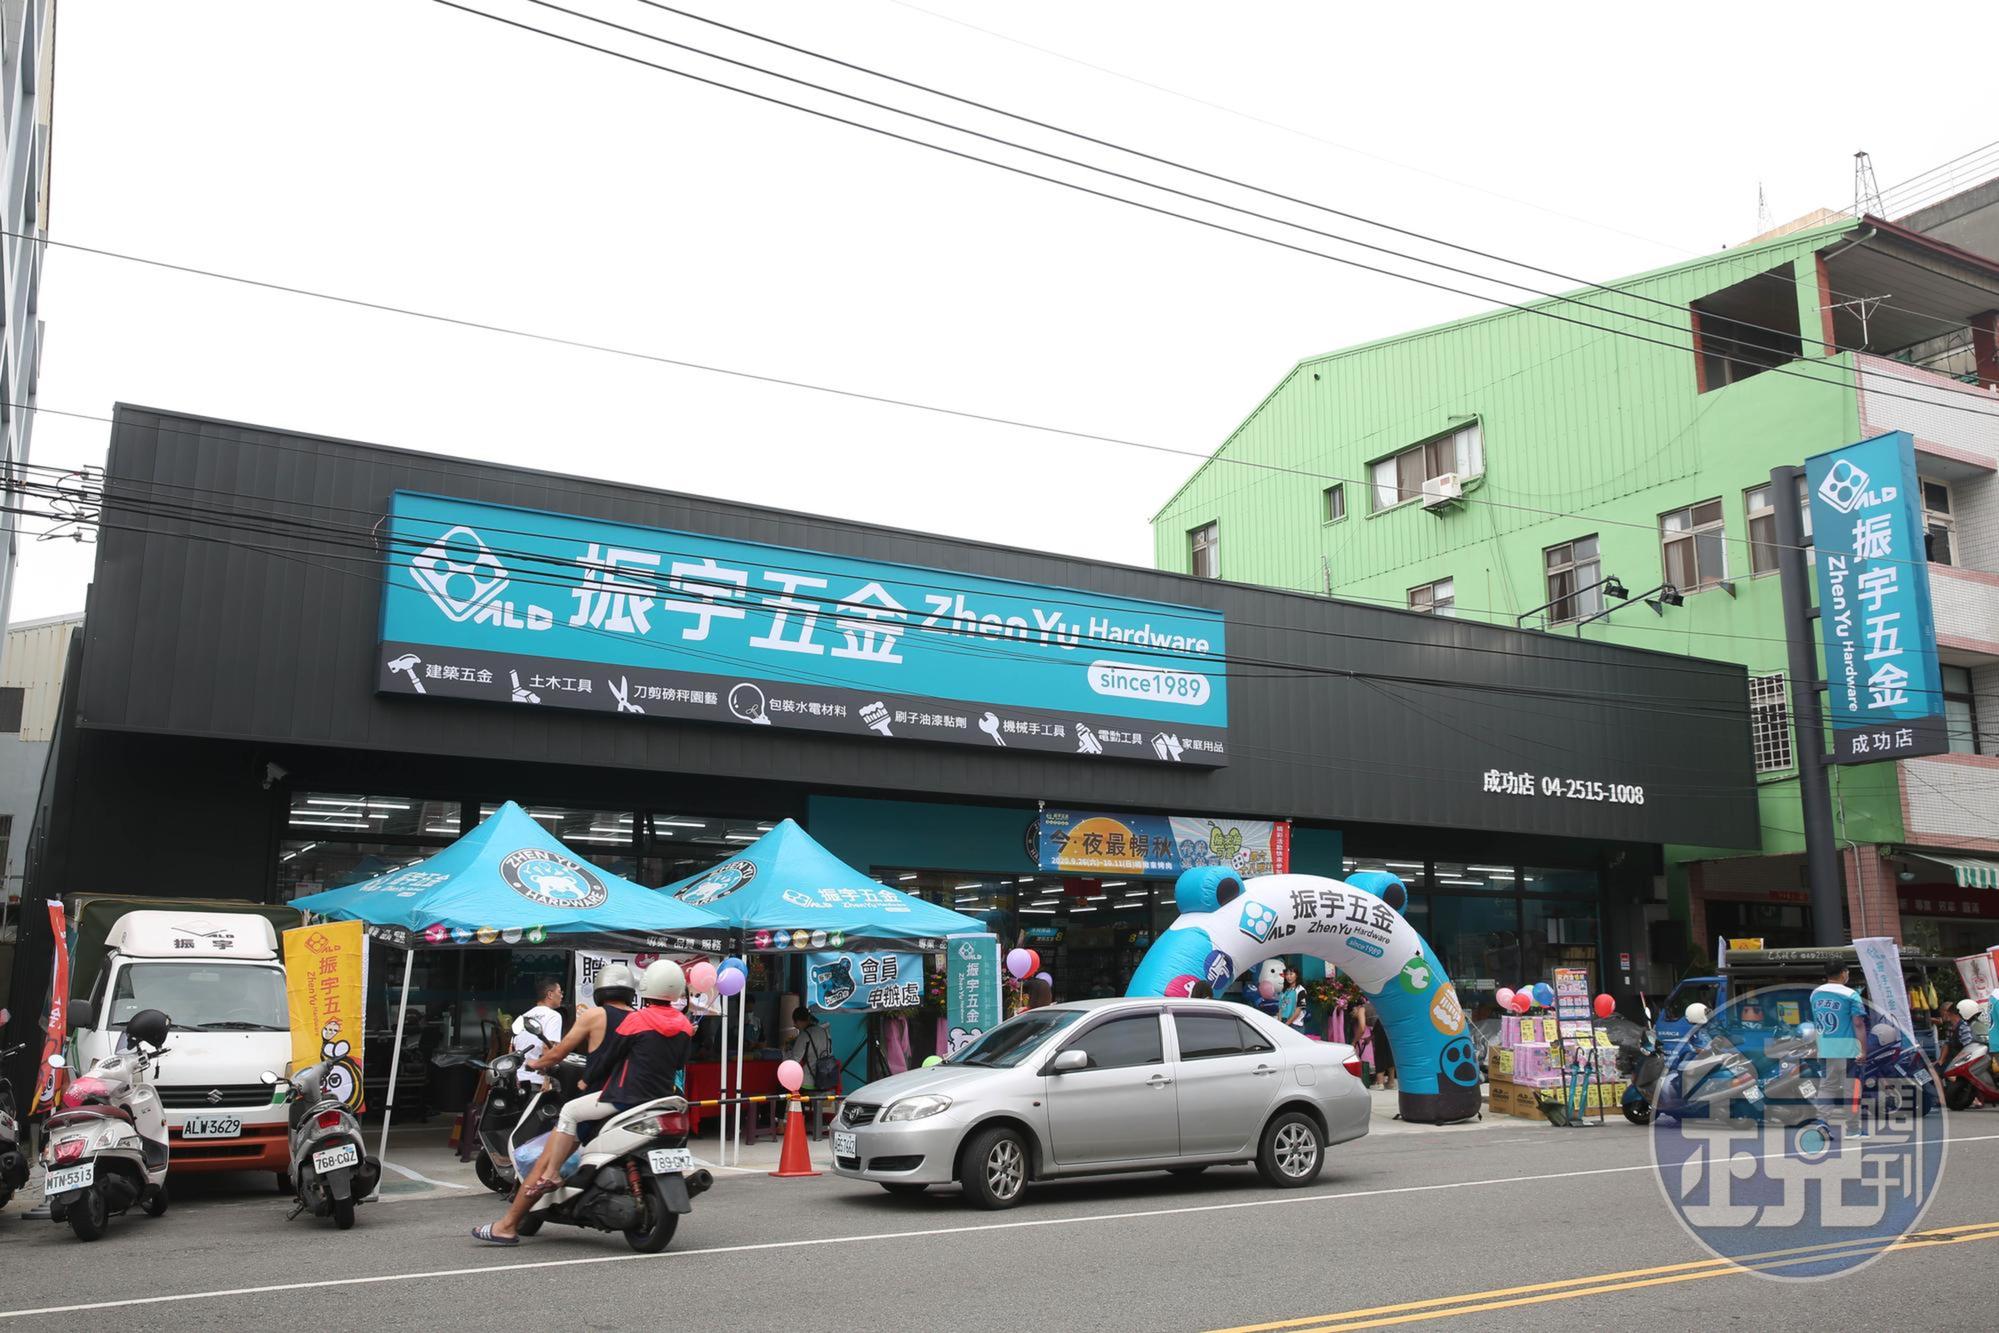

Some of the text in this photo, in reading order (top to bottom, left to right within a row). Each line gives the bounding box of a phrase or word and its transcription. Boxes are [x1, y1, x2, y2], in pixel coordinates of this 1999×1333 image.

[568, 542, 909, 665] 振宇五金
[1852, 513, 1909, 710] 振宇五金
[1088, 616, 1210, 656] Hardware
[425, 663, 493, 685] 建築五金
[529, 673, 593, 694] 土木工具
[1100, 669, 1201, 699] since1989
[1842, 640, 1858, 711] Hardware
[633, 684, 718, 706] 刀剪磅秤園藝
[768, 697, 847, 718] 包裝水電材料
[1003, 719, 1066, 739] 機械手工具
[1098, 729, 1143, 746] 電動工具
[1182, 738, 1225, 755] 家庭用品
[1852, 728, 1913, 755] 成功店
[1483, 768, 1645, 806] 成功店 04-2515-1008
[505, 850, 582, 872] ZHEN YU
[526, 889, 604, 909] HARDWARE
[818, 887, 903, 903] 振宇五金
[1290, 889, 1395, 935] 振宇五金
[1353, 926, 1391, 945] Hardware
[860, 955, 899, 984] 會員
[867, 982, 921, 1009] 申辦處
[966, 962, 980, 1024] 振宇五金
[184, 1118, 241, 1136] ALW-3629
[315, 1151, 356, 1170] 768-CQZ
[46, 1168, 92, 1190] MTN-5313
